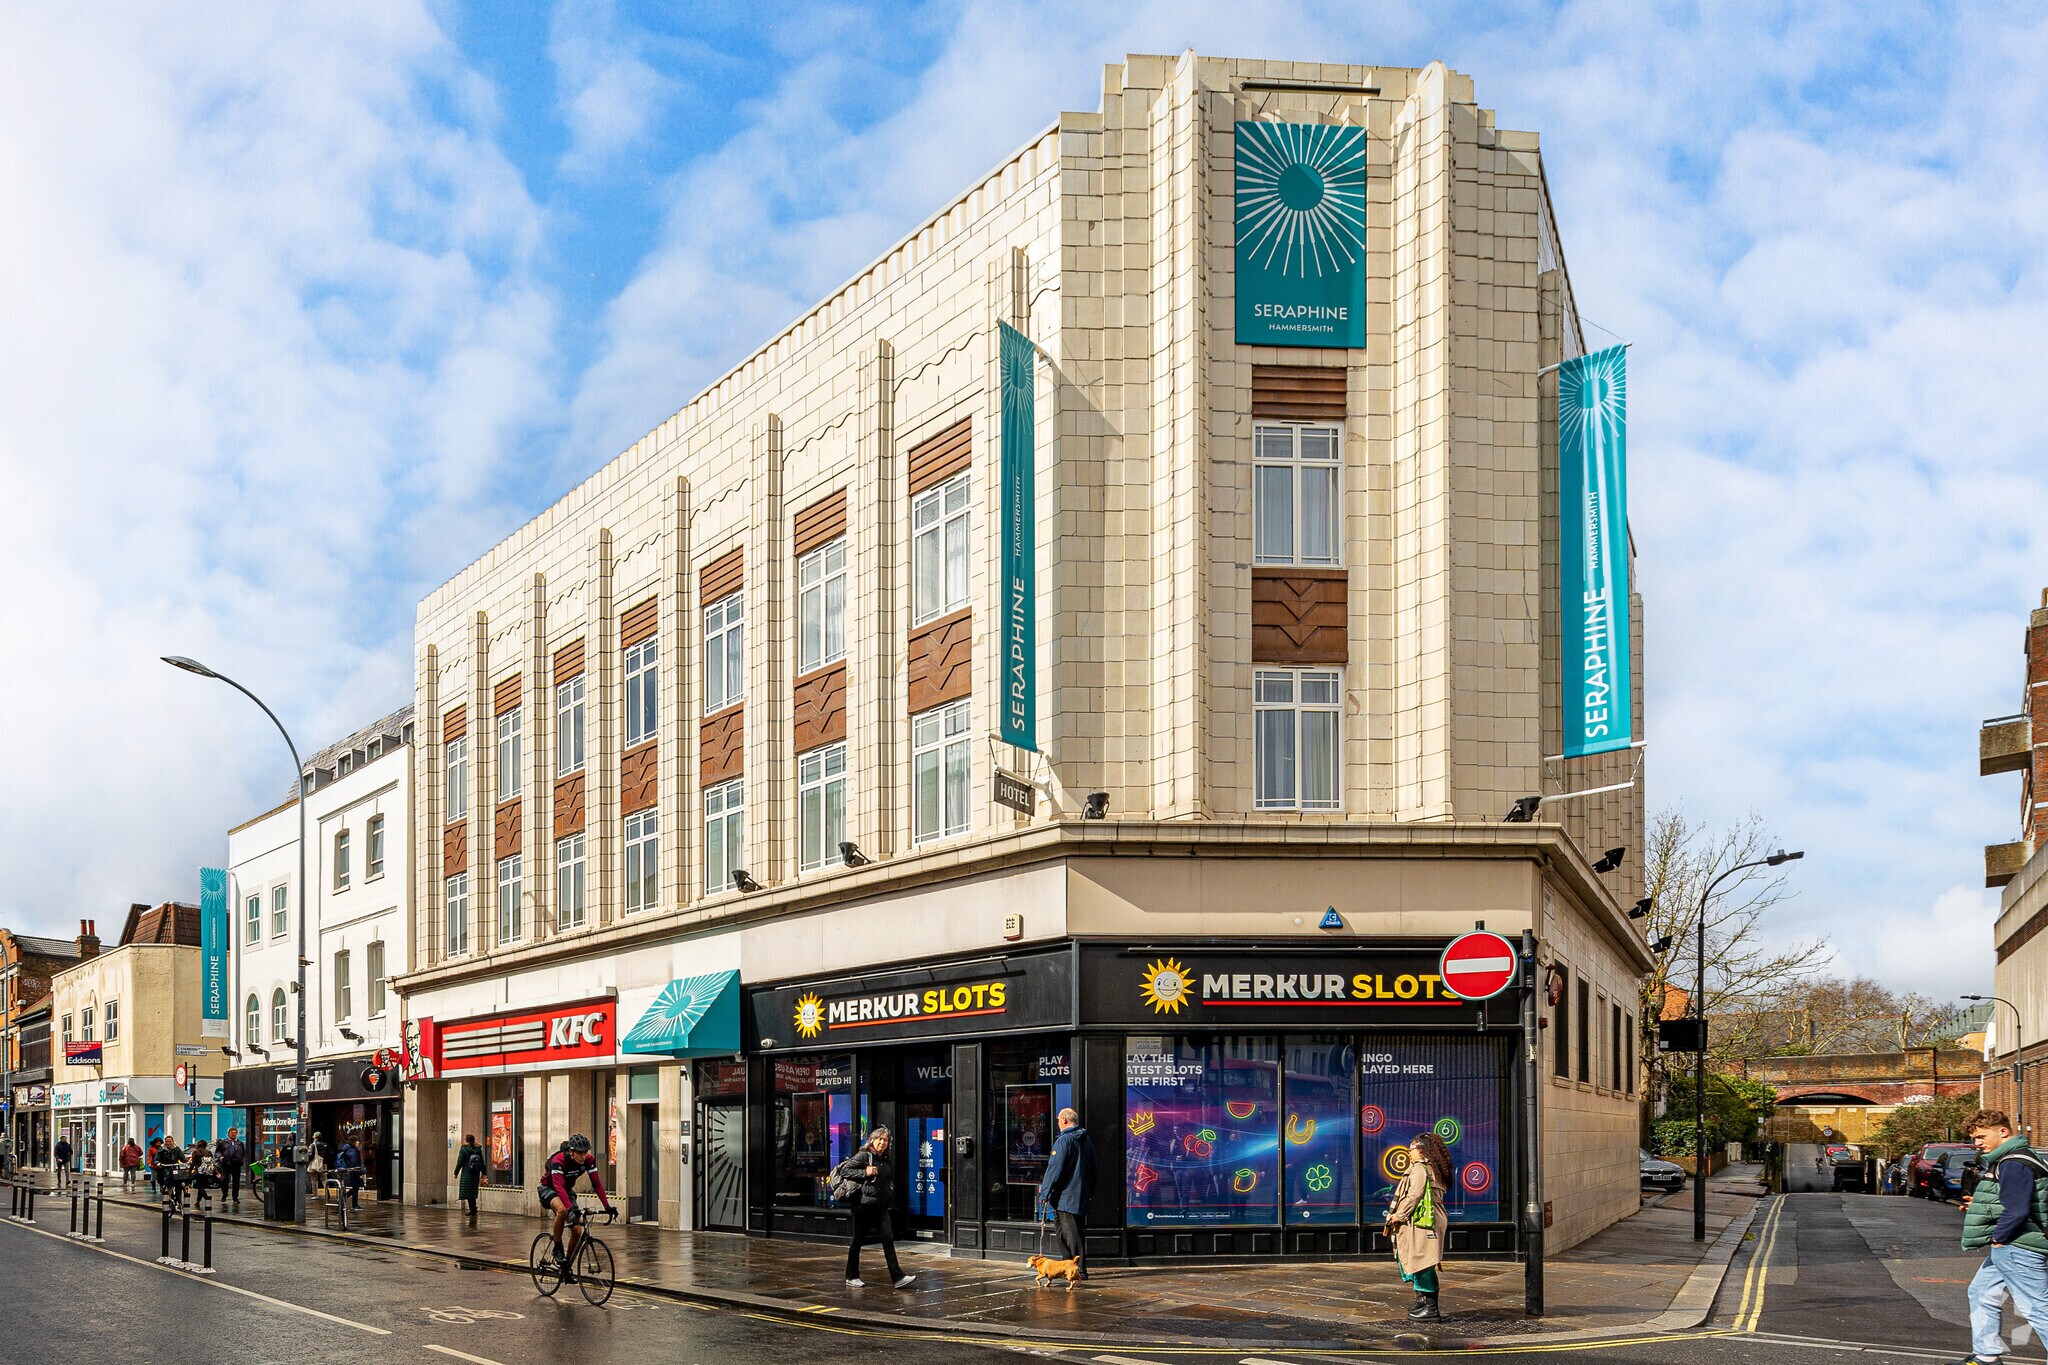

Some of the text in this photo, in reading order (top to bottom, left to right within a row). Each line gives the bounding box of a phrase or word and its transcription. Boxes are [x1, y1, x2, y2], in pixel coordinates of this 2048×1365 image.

[1254, 304, 1348, 320] SERAPHINE
[1269, 323, 1334, 333] HAMMERSMITH
[1589, 490, 1598, 569] HAMMERSMITH
[1011, 576, 1025, 732] SERAPHINE
[1583, 587, 1608, 737] SERAPHINE
[1000, 782, 1030, 807] HOTEL
[210, 955, 219, 1014] SERAPHINE
[1203, 974, 1345, 998] MERKUR
[828, 982, 1007, 1024] MERKUR SLOTS
[548, 1012, 605, 1048] KFC
[1039, 1056, 1063, 1066] PLAY
[1126, 1053, 1174, 1063] LAY THE
[1362, 1053, 1393, 1063] INGO
[815, 1068, 838, 1077] BINGO
[917, 1065, 953, 1079] WELC
[1039, 1066, 1070, 1077] SLOTS
[1126, 1065, 1203, 1075] ATEST SLOTS
[1362, 1064, 1434, 1074] LAYED HERE
[276, 1074, 298, 1094] German
[815, 1077, 842, 1086] PLAYED
[1127, 1077, 1186, 1086] ERE FIRST
[1365, 1112, 1375, 1124] 3
[1441, 1123, 1450, 1135] 6
[1395, 1154, 1407, 1169] 8
[1471, 1169, 1480, 1181] 2
